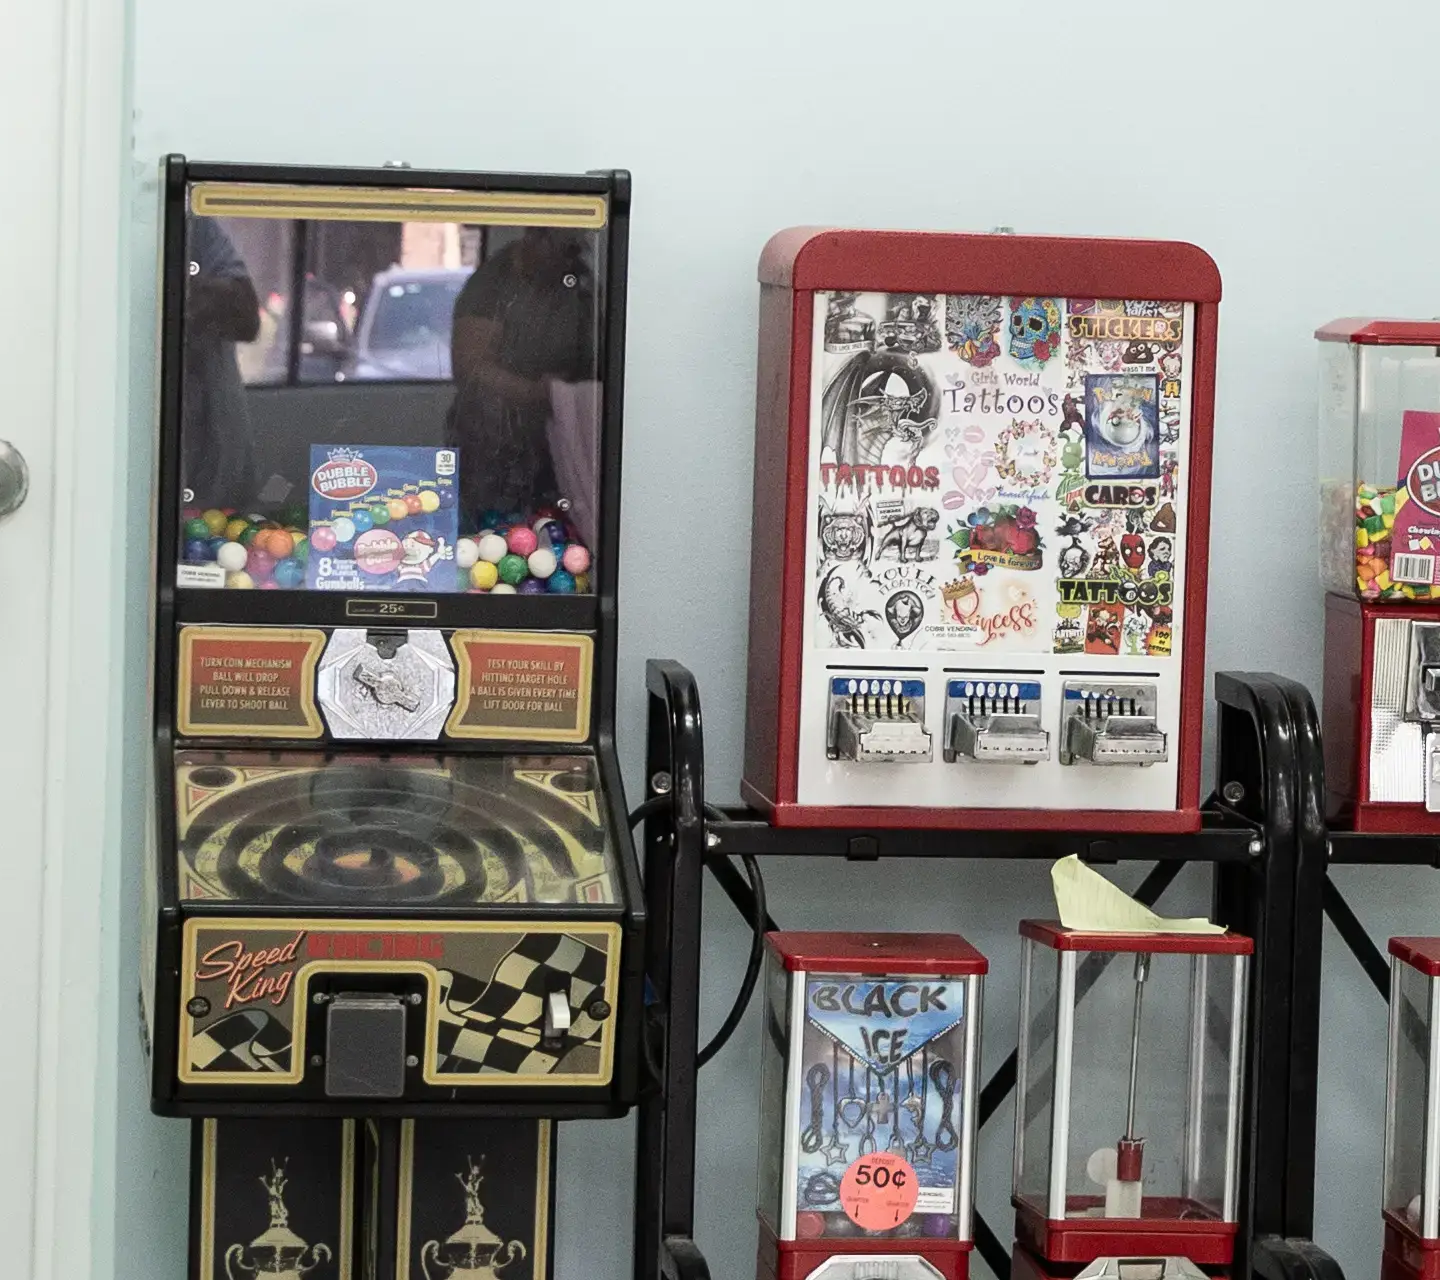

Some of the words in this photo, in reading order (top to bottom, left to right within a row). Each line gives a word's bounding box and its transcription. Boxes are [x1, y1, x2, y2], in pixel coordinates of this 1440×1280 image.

[1069, 315, 1182, 341] STICKERS
[971, 372, 999, 385] Girls
[1004, 373, 1040, 387] World
[943, 380, 1059, 416] Tattoos
[440, 453, 452, 463] 30
[317, 466, 369, 481] DUBBLE
[819, 462, 941, 491] TATTOOS
[320, 477, 372, 492] BUBBLE
[1085, 484, 1157, 506] CARDS
[977, 552, 998, 563] Love
[999, 556, 1006, 565] is
[318, 557, 333, 577] 8
[315, 576, 365, 591] Gumballs
[1060, 580, 1172, 603] TATTOOS
[379, 603, 405, 614] 25¢
[200, 658, 222, 668] TURN
[223, 658, 243, 668] COIN
[243, 658, 292, 669] MECHANISM
[488, 659, 506, 669] TEST
[507, 660, 530, 670] YOUR
[531, 661, 552, 671] SKILL
[554, 661, 565, 671] BY
[213, 671, 232, 681] BALL
[234, 672, 254, 682] WILL
[256, 672, 279, 683] DROP
[482, 672, 514, 683] HITTING
[516, 673, 546, 684] TARGET
[548, 675, 568, 685] HOLE
[200, 685, 219, 695] PULL
[222, 686, 247, 696] DOWN
[249, 686, 256, 696] &
[257, 686, 290, 697] RELEASE
[470, 686, 476, 696] A
[477, 686, 497, 696] BALL
[498, 687, 506, 696] IS
[507, 687, 531, 697] GIVEN
[533, 688, 557, 698] EVERY
[558, 688, 577, 699] TIME
[201, 699, 225, 709] LEVER
[228, 699, 238, 709] TO
[240, 700, 267, 710] SHOOT
[269, 701, 289, 710] BALL
[483, 700, 500, 710] LIFT
[502, 701, 525, 711] DOOR
[527, 701, 543, 711] FOR
[544, 702, 563, 712] BALL
[305, 933, 445, 959] RACING
[195, 930, 308, 982] Speed
[224, 967, 294, 1009] King
[812, 984, 947, 1018] BLACK
[859, 1026, 908, 1065] ICE
[855, 1164, 906, 1190] 50¢
